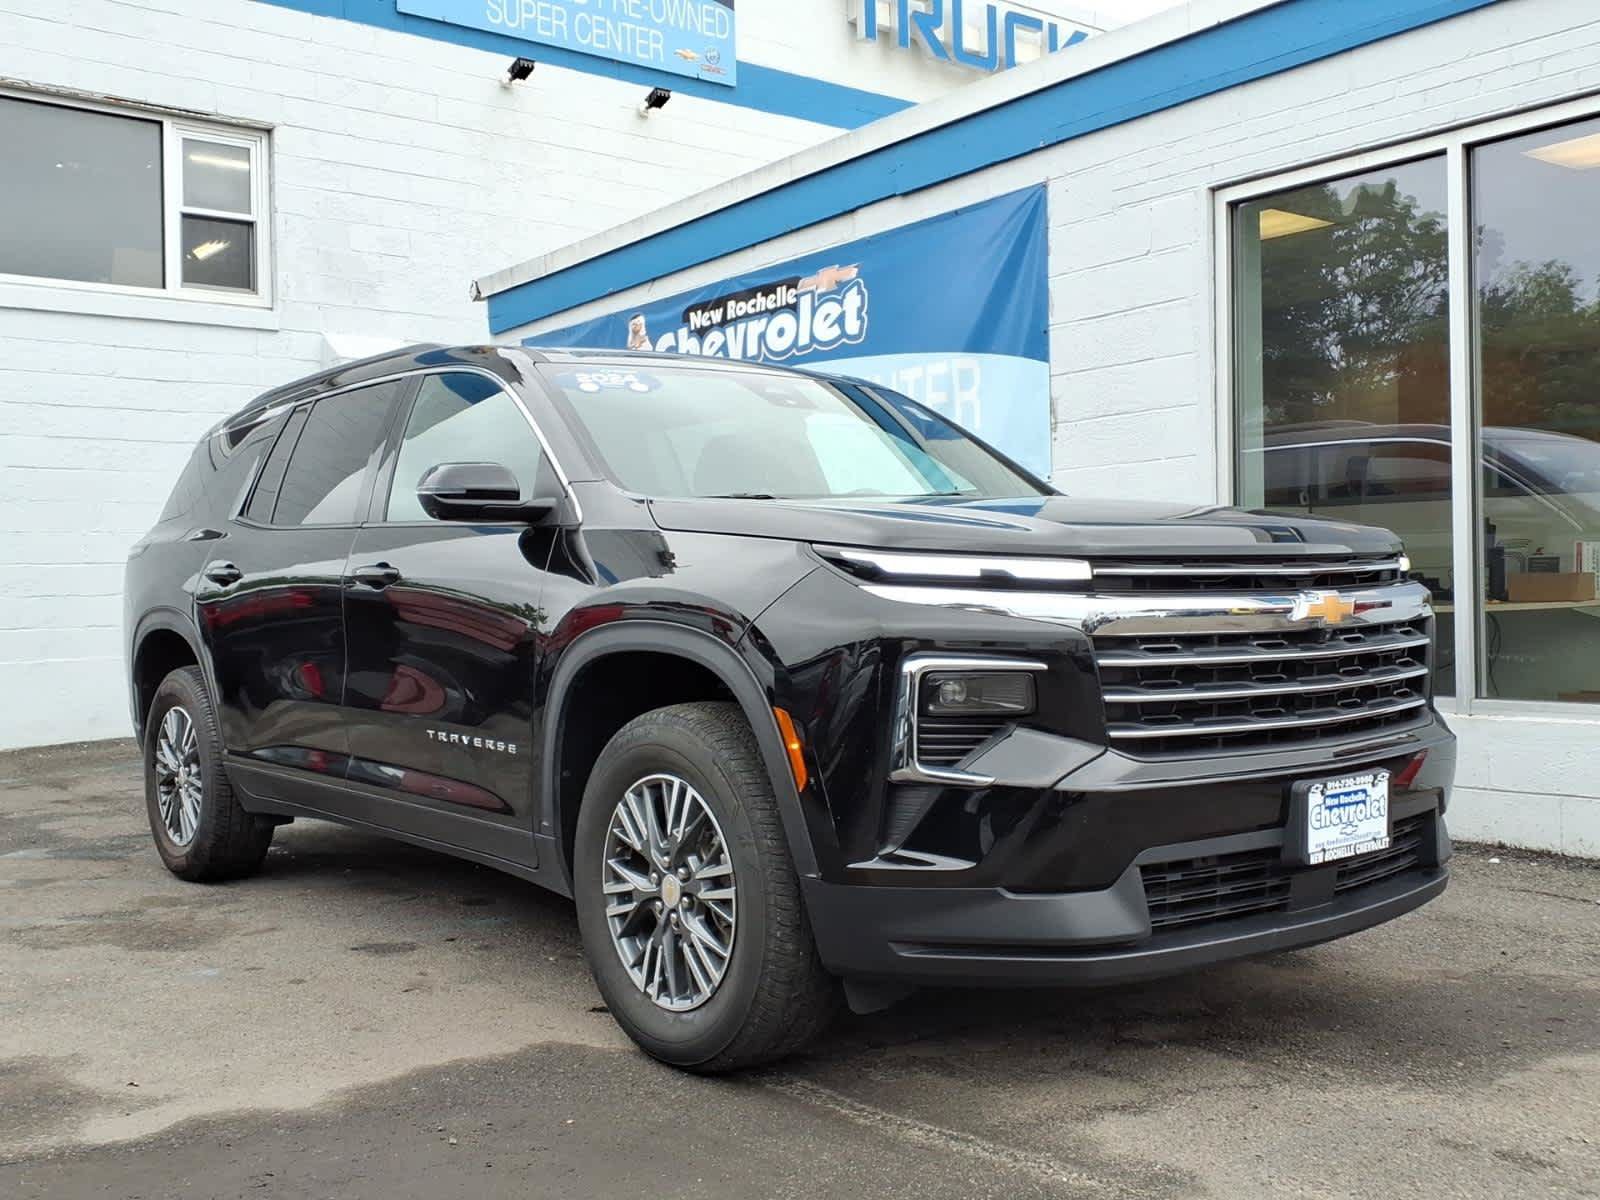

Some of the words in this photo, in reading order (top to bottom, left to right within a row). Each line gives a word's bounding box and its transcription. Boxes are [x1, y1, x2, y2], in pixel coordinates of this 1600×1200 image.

[486, 0, 568, 41] SUPER
[574, 12, 664, 62] CENTER
[600, 0, 729, 39] E-OWNED
[689, 306, 724, 331] New
[726, 284, 798, 319] Rochelle
[426, 729, 517, 754] TRAVERSE
[1310, 795, 1385, 830] Chevrolet
